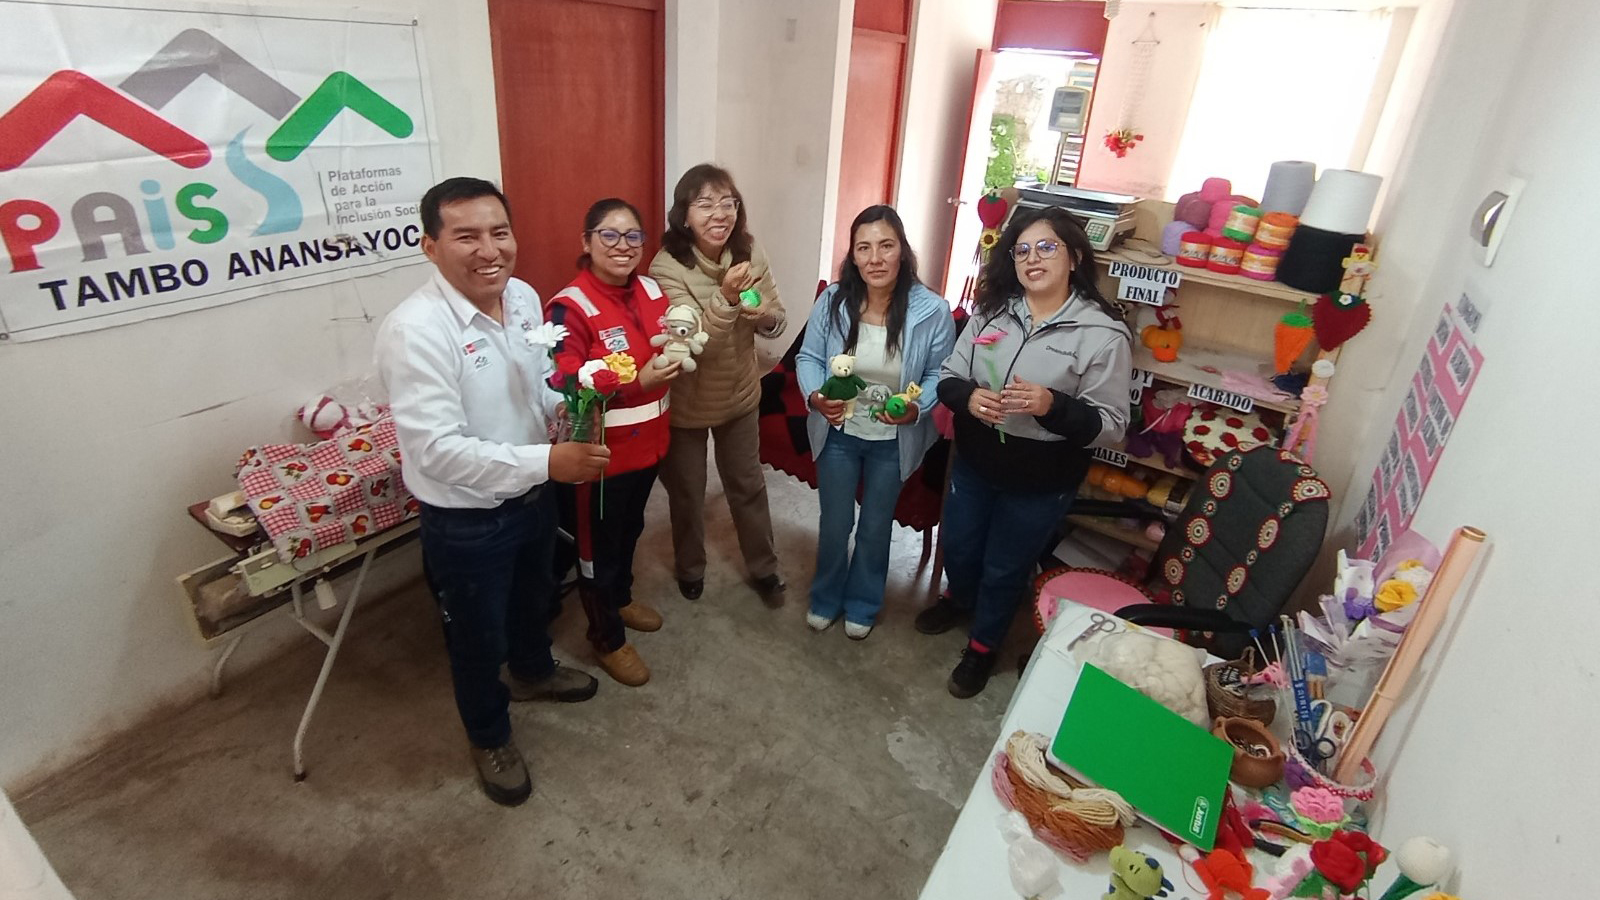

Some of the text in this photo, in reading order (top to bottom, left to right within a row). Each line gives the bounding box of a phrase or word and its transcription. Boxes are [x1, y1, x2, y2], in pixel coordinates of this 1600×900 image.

[328, 167, 402, 181] Plataformas
[331, 180, 393, 196] de Acción
[335, 197, 376, 213] para la
[337, 210, 391, 224] Inclusión
[38, 224, 420, 311] TAMBO ANANSAYOC
[1111, 261, 1178, 285] PRODUCTO
[1125, 286, 1159, 303] FINAL
[1189, 383, 1251, 411] ACABADO
